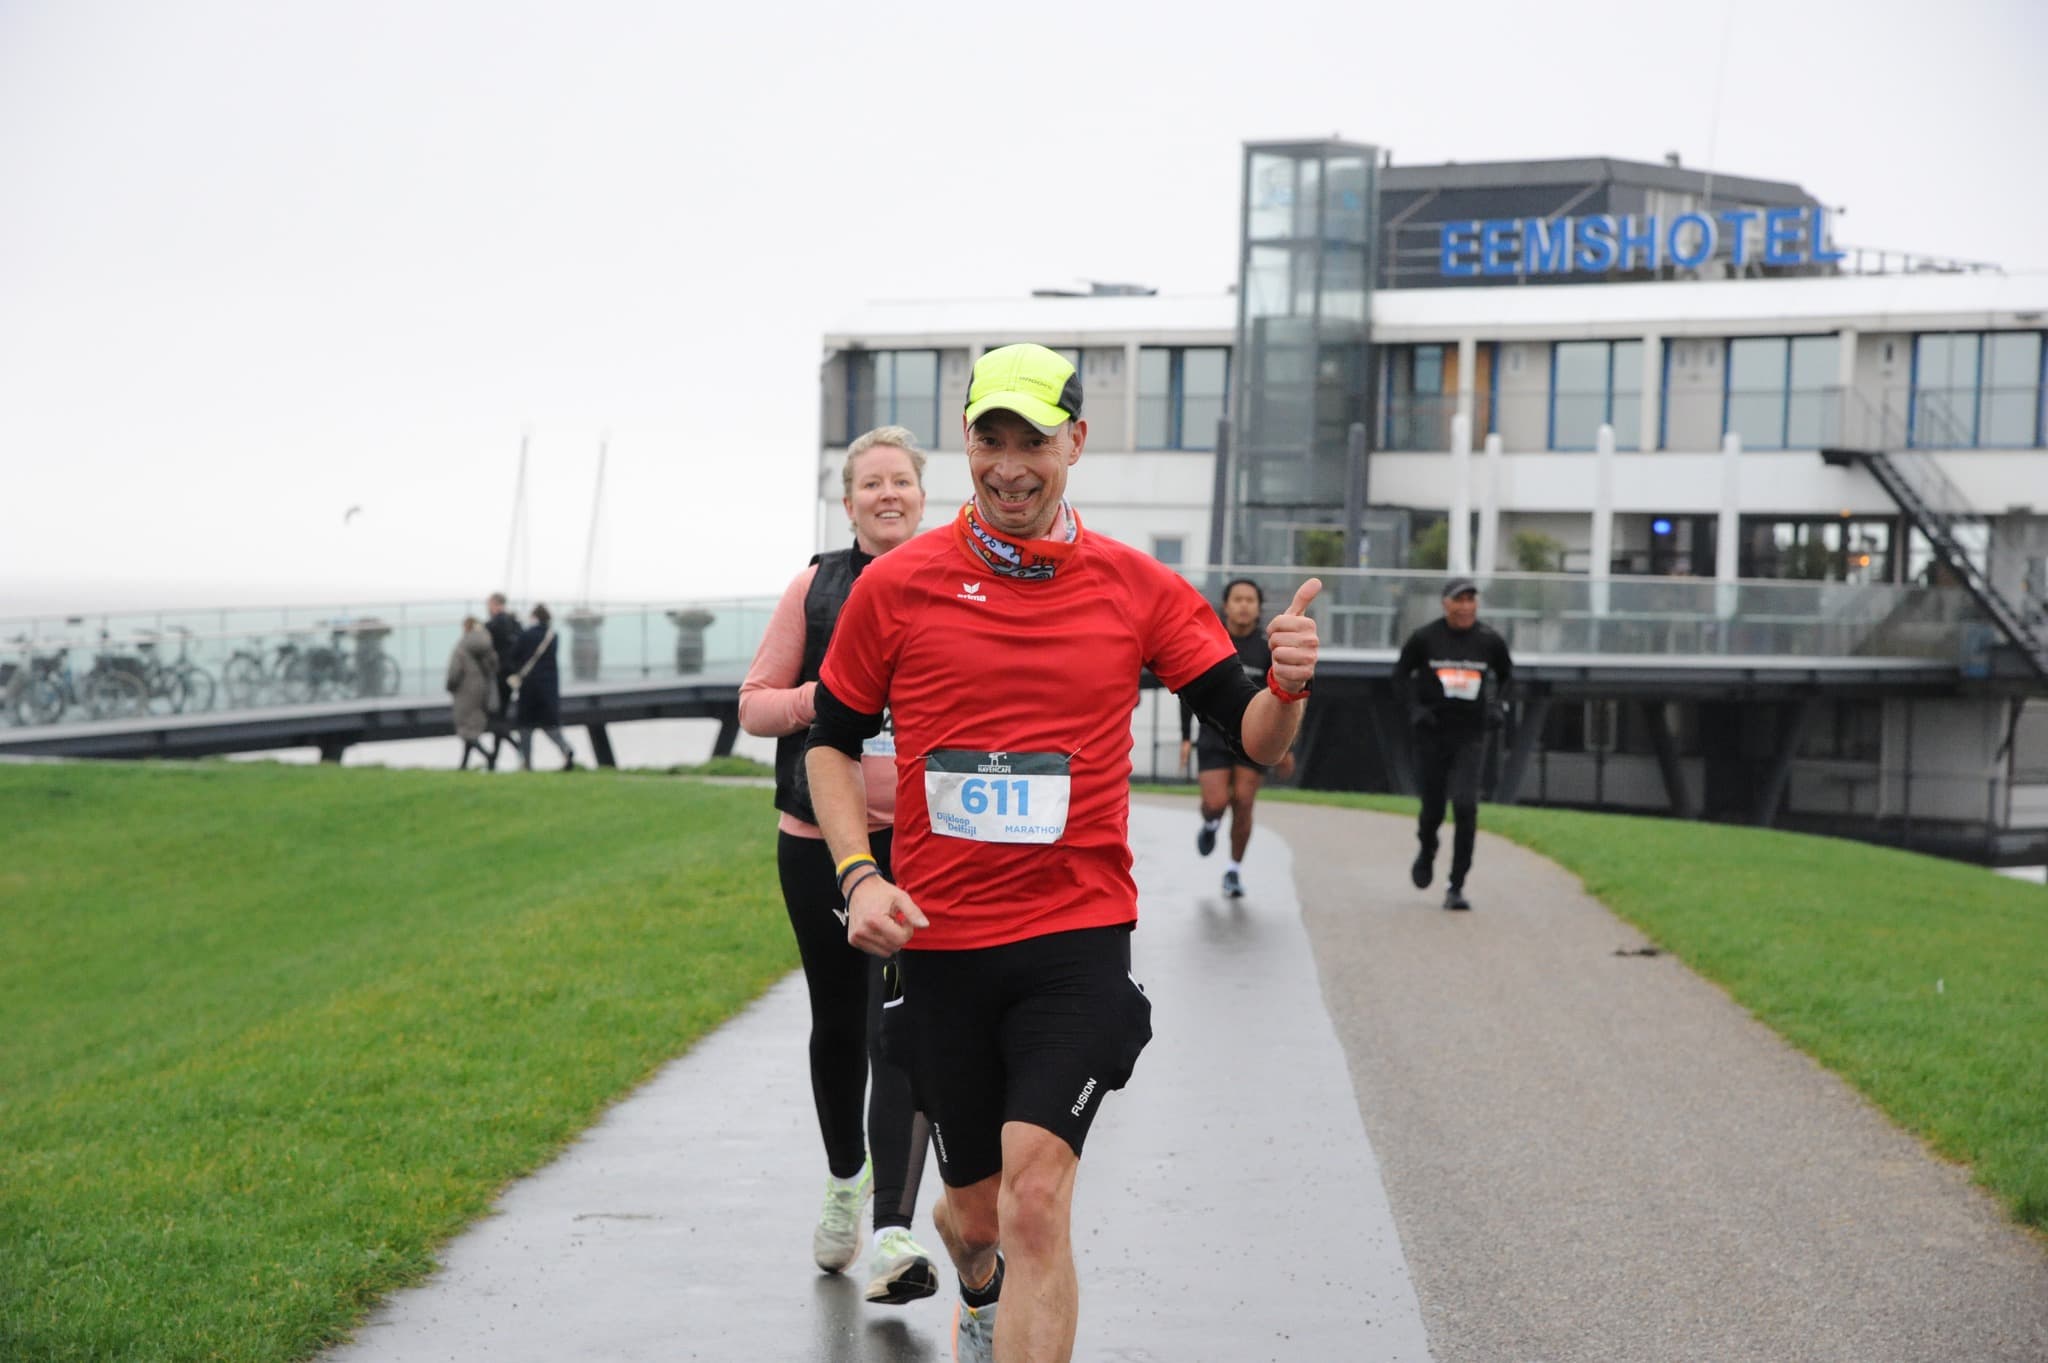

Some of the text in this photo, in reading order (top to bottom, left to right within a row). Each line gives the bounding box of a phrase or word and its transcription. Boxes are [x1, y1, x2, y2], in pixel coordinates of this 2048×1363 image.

[1440, 206, 1846, 276] EEMSHOTEL
[961, 779, 1029, 815] 611
[936, 812, 970, 826] Dijkloop
[948, 823, 976, 837] Delfzijl
[1005, 825, 1061, 834] MARATHON
[1071, 1077, 1097, 1117] FUSION
